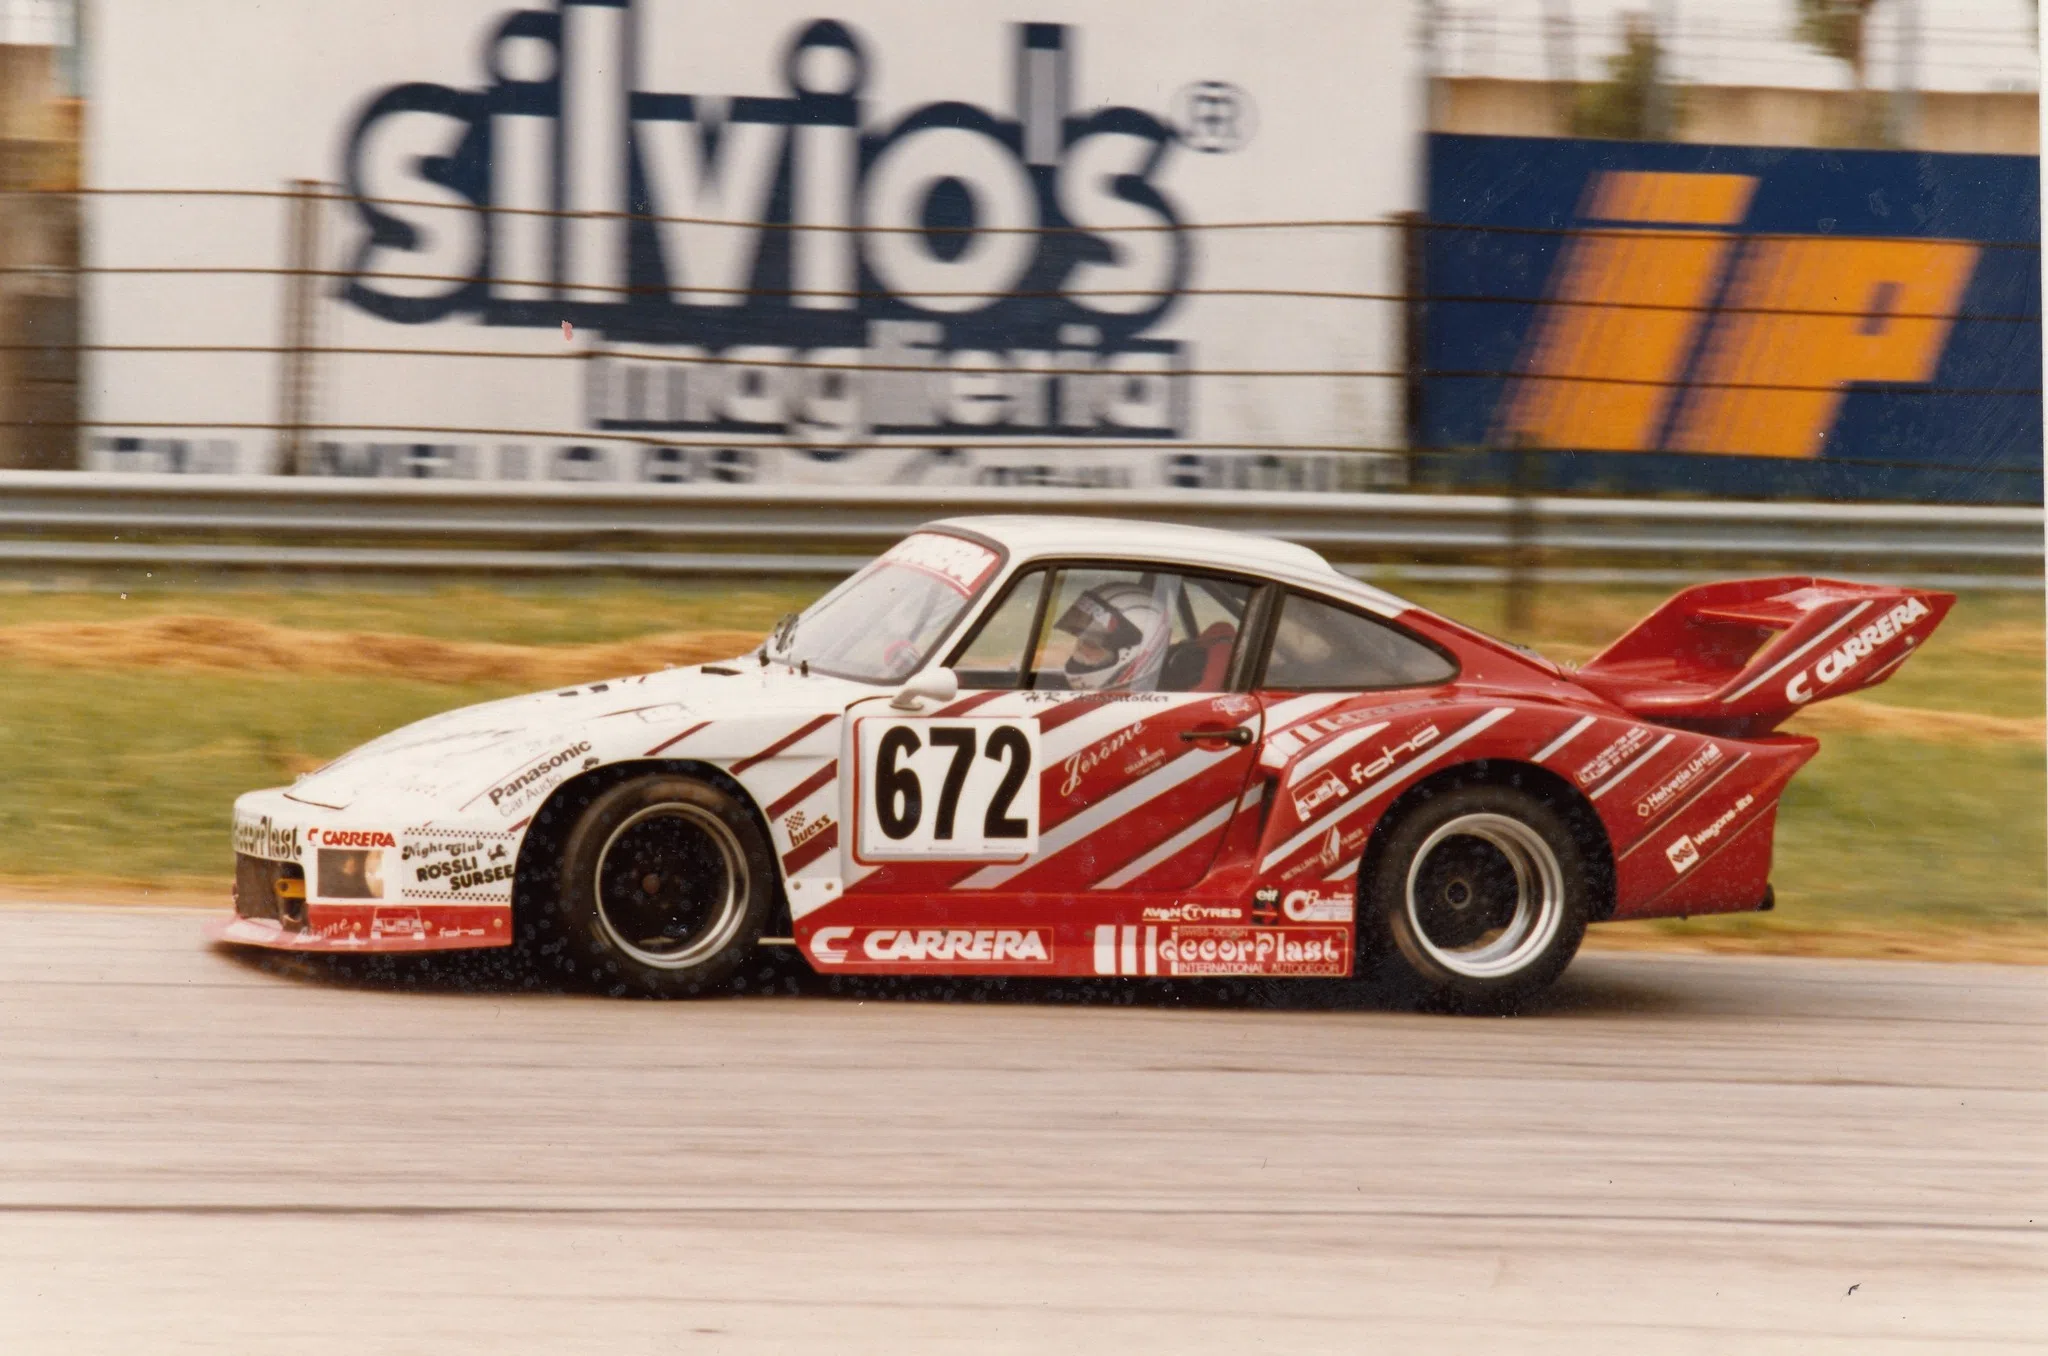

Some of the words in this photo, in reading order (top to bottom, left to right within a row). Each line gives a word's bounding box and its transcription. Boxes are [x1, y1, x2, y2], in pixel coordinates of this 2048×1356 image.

[338, 0, 1192, 324] silvio's
[1816, 596, 1930, 684] CARRERA
[488, 740, 593, 806] Panasonic
[525, 772, 563, 801] Audio
[874, 725, 1032, 840] 672
[1647, 769, 1692, 807] Helvetia
[322, 830, 397, 848] CARRERA
[401, 841, 443, 860] Night
[445, 840, 484, 857] Club
[416, 855, 478, 882] RÖSSLI
[449, 864, 515, 891] SURSEE
[1255, 888, 1279, 901] elf
[1142, 907, 1181, 920] AVON
[1186, 905, 1243, 920] TYRES
[863, 930, 1049, 961] CARRERA
[1179, 963, 1265, 974] INTERNATIONAL
[1271, 963, 1340, 974] AUTODECOR
